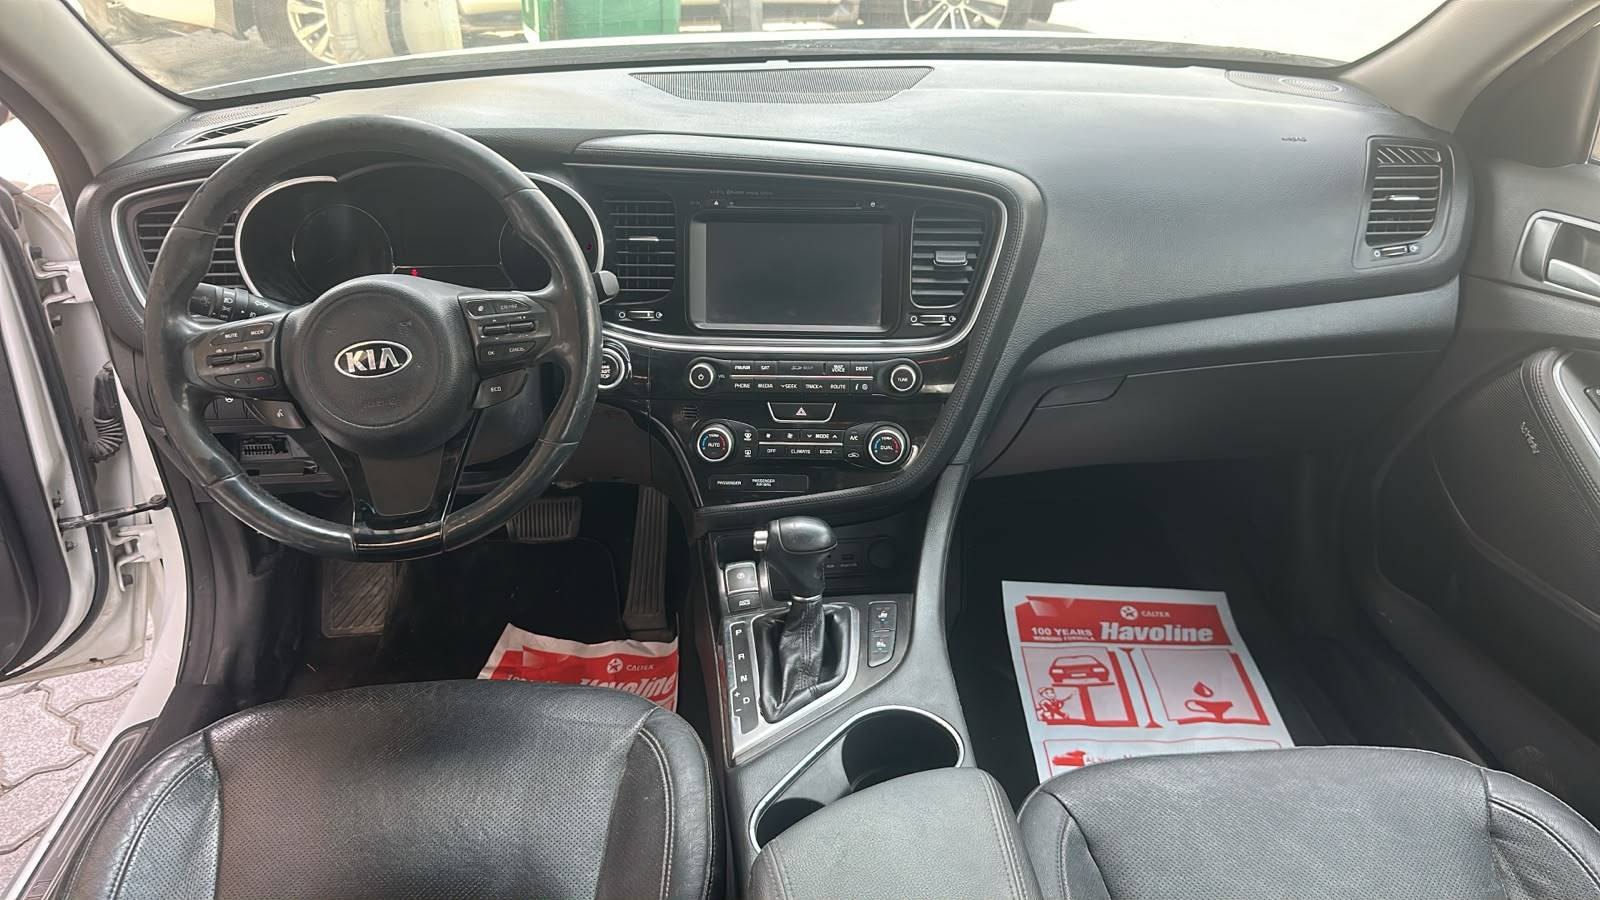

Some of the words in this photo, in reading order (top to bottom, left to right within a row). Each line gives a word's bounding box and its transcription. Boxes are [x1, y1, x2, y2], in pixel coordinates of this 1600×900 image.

[345, 347, 400, 373] KIA
[1140, 610, 1171, 618] CALTEX
[1031, 626, 1052, 636] 100
[1053, 628, 1093, 638] YEARS
[1100, 621, 1214, 643] Havoline
[625, 664, 655, 672] CALTEX
[740, 674, 748, 682] N
[742, 696, 750, 704] D
